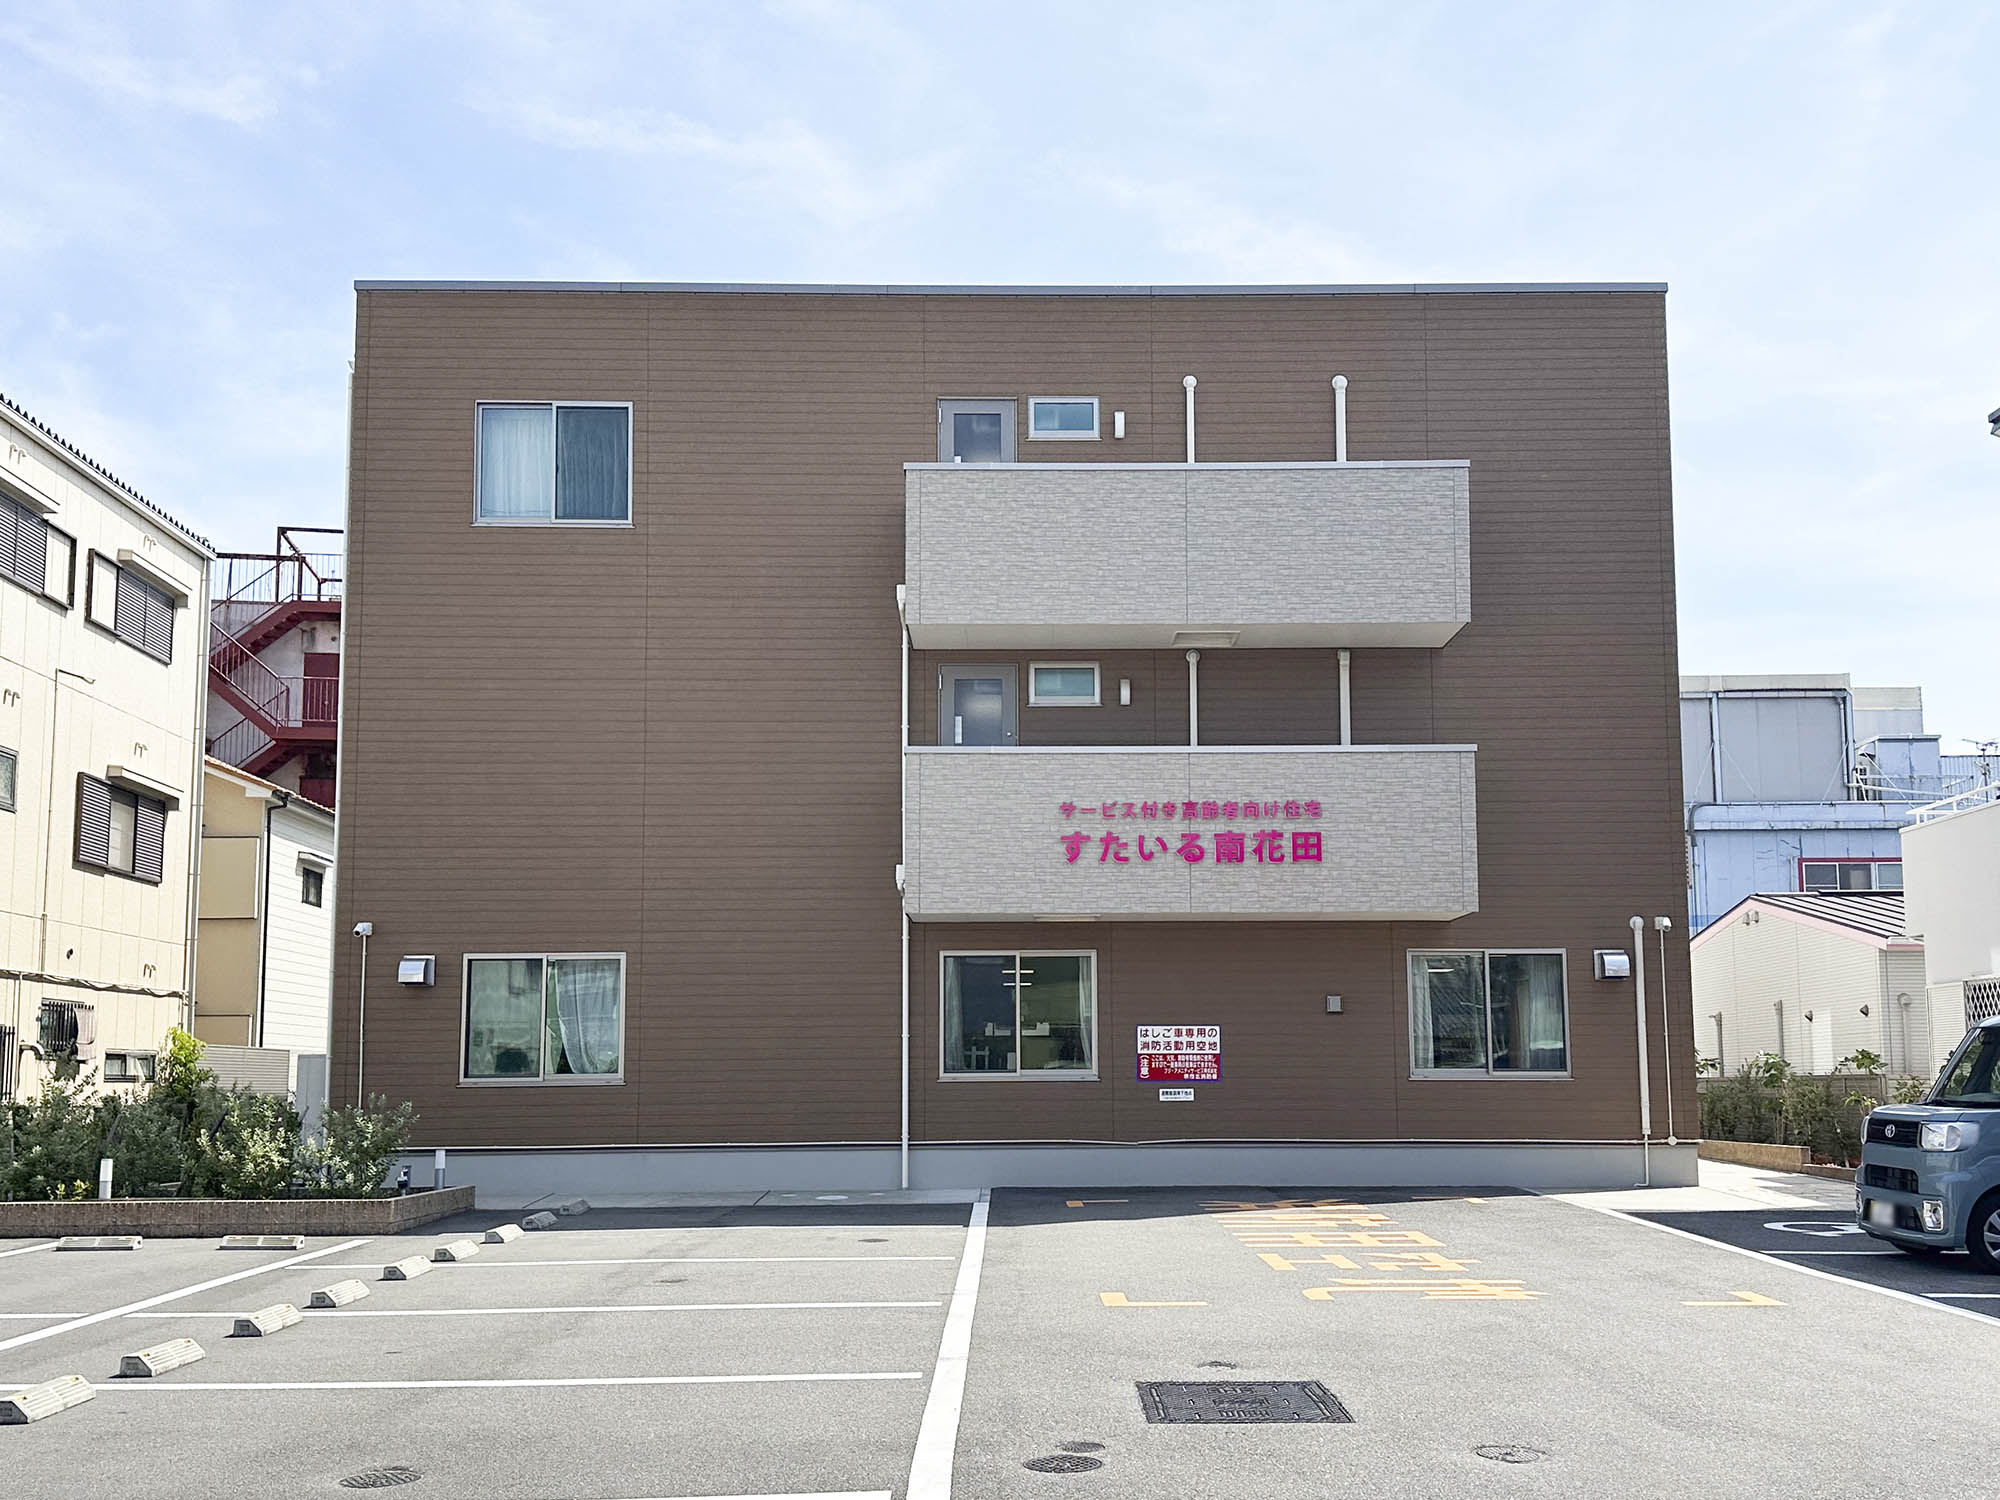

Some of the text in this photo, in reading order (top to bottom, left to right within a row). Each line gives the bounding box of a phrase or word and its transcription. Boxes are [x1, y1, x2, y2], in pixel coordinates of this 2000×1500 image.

[1059, 800, 1322, 819] サービス付き高齢者向け住宅
[1059, 829, 1323, 864] すたいる南花田
[1139, 1027, 1218, 1039] はしご車専用の
[1140, 1040, 1217, 1051] 消防活動用空地
